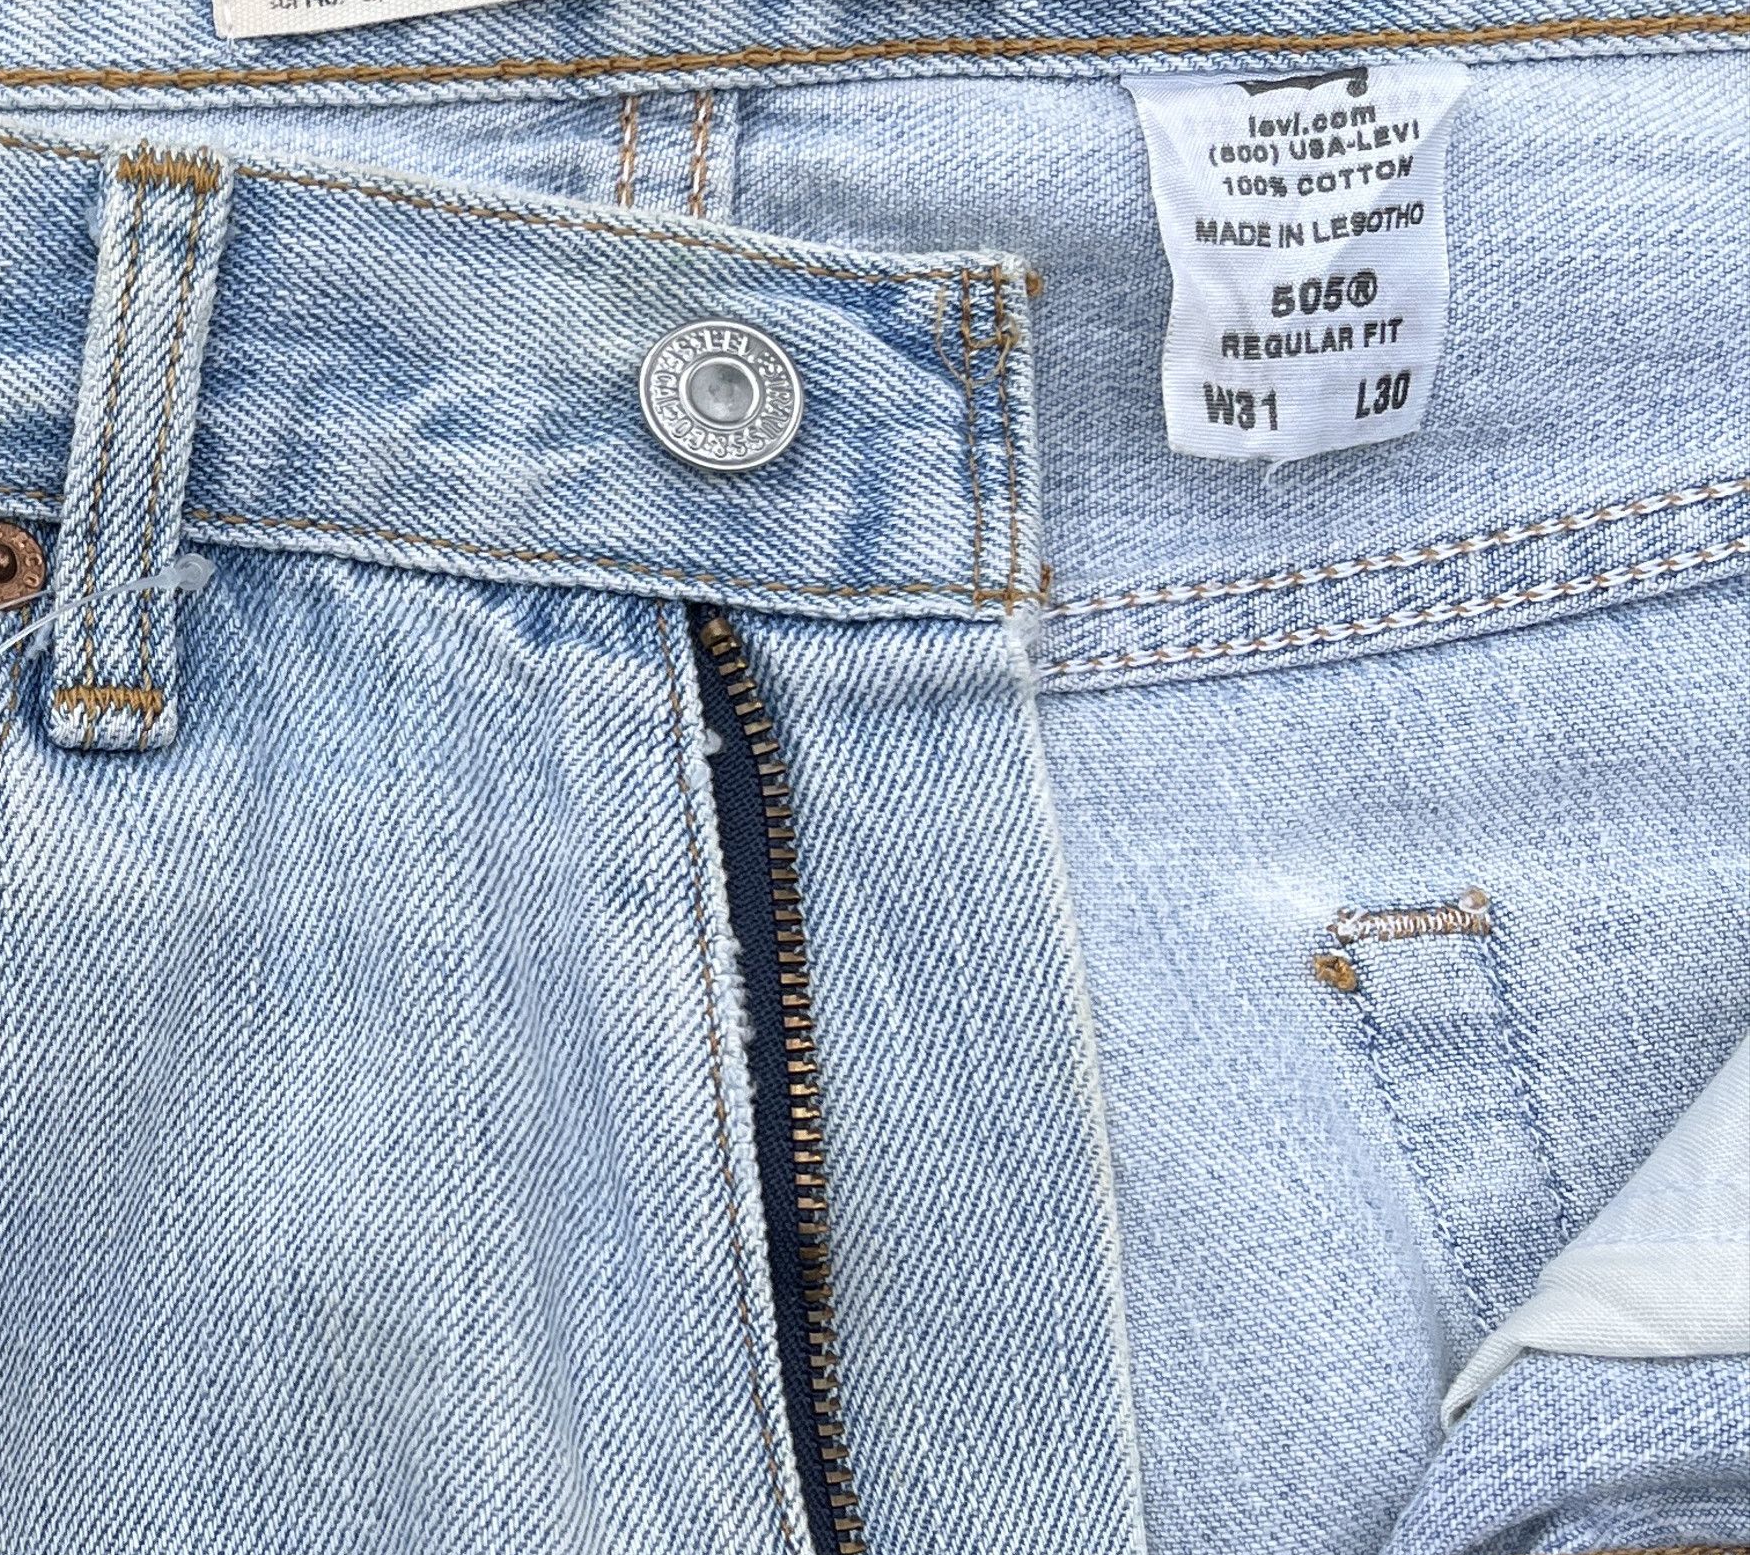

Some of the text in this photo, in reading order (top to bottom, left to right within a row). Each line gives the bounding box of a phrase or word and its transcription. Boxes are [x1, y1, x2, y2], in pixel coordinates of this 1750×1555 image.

[1209, 120, 1421, 167] (800) USA-LEVI
[1248, 105, 1376, 138] levi.com
[1222, 155, 1414, 198] 100% COTTON
[1195, 201, 1425, 249] MADE IN LESOTHO
[1220, 317, 1404, 360] REGULAR FIT
[1202, 372, 1412, 431] W31 L30
